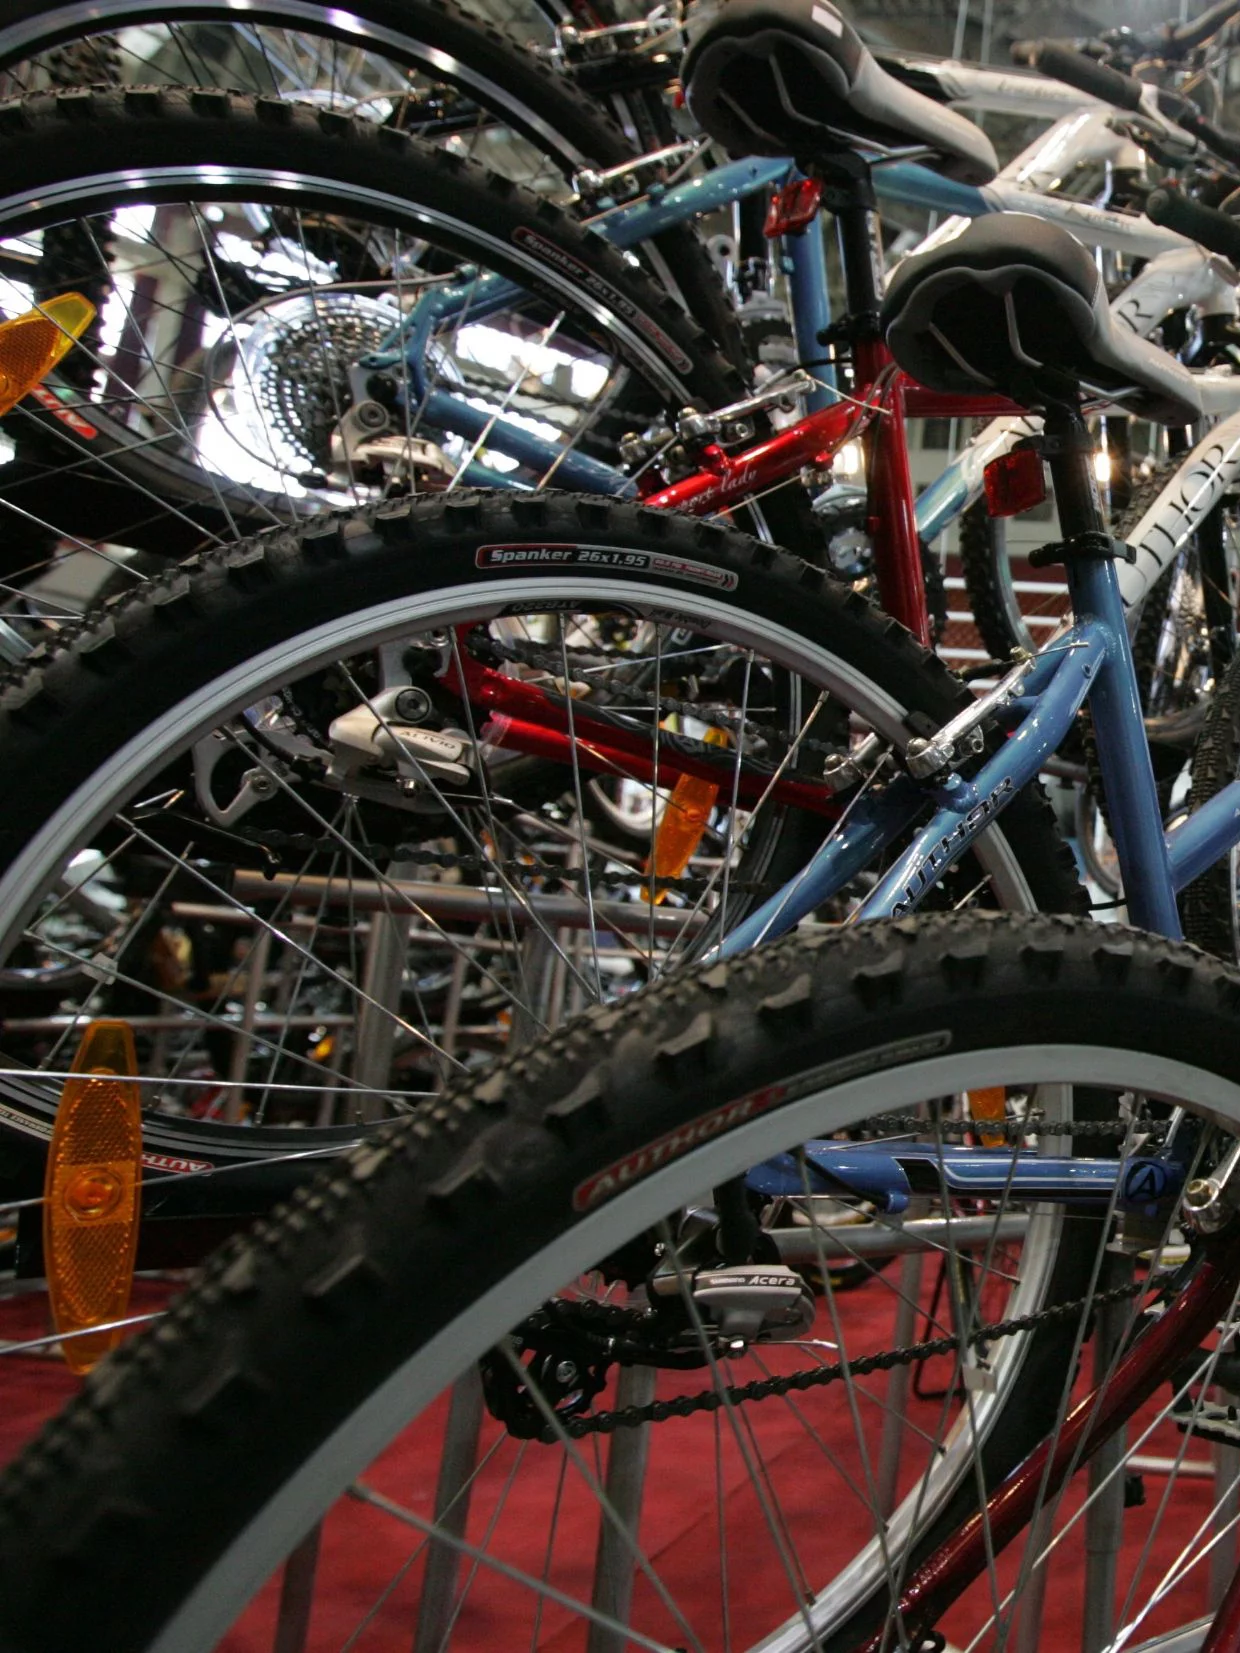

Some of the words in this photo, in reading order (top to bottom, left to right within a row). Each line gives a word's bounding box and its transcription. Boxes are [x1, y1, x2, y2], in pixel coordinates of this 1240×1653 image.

[523, 234, 585, 276] Spanker
[490, 548, 573, 566] Spanker
[577, 550, 648, 567] 26x1.95
[588, 1098, 757, 1200] AUTHOR
[141, 1152, 209, 1175] AUTH
[748, 1275, 796, 1286] Acera
